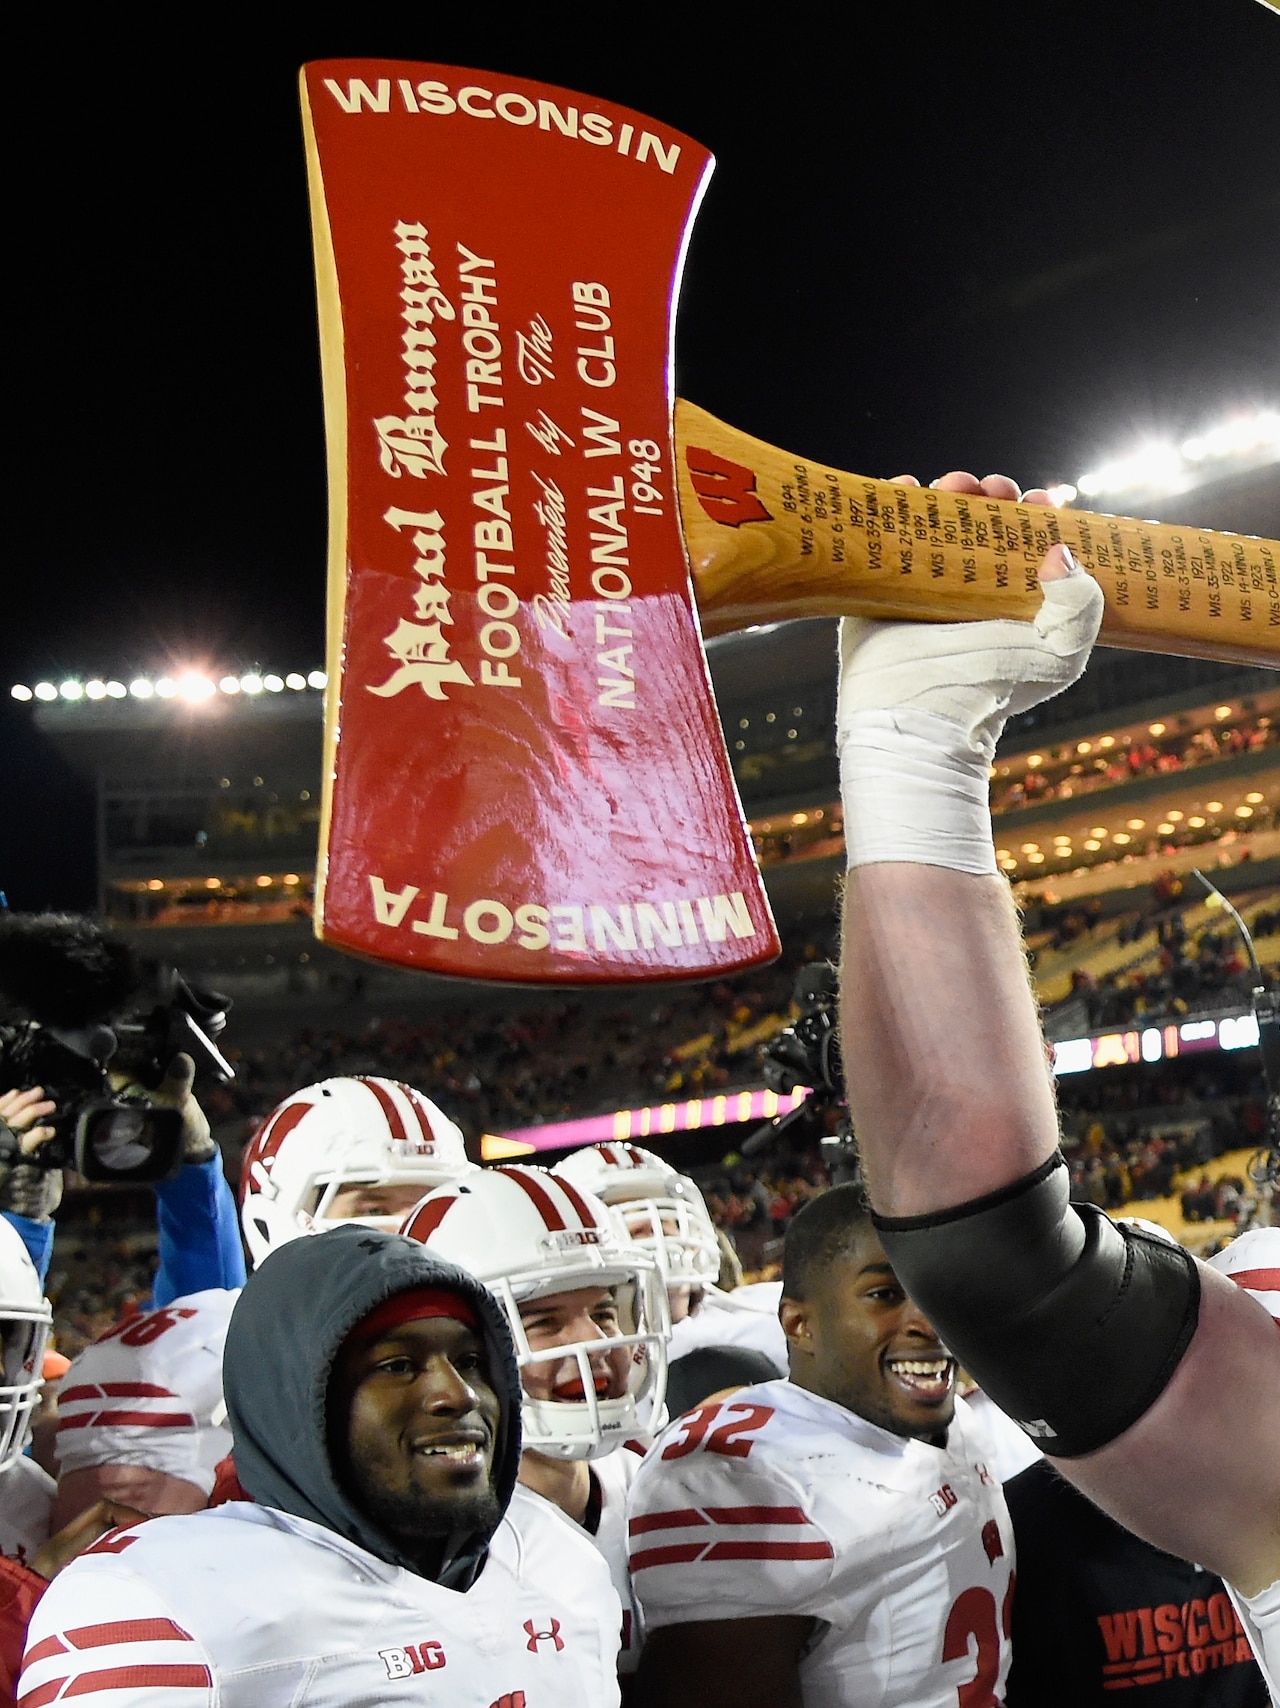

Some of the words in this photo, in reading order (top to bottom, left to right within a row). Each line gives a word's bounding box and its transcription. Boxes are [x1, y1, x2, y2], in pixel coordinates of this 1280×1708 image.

[324, 79, 681, 175] WISCONSIN
[457, 241, 504, 413] TROPHY
[572, 281, 617, 388] CLUB
[374, 220, 455, 480] Bunyan
[516, 312, 555, 386] The
[525, 409, 576, 456] by
[581, 408, 623, 458] W
[629, 439, 663, 515] 1948
[782, 485, 797, 513] 1894
[815, 491, 827, 519] 1896
[850, 498, 864, 527] 1897
[882, 505, 895, 533] 1898
[914, 515, 927, 540] 1899
[944, 521, 957, 544] 1901
[976, 520, 989, 548] 1905
[1006, 525, 1019, 551] 1907
[1035, 530, 1048, 557] 1908
[472, 428, 522, 687] FOOTBALL
[531, 468, 573, 641] Presented
[1097, 545, 1110, 567] 1912
[1128, 549, 1142, 573] 1917
[1161, 550, 1175, 578] 1920
[1191, 557, 1205, 579] 1921
[1221, 561, 1235, 586] 1922
[1251, 565, 1264, 591] 1923
[366, 505, 475, 700] Paul
[587, 474, 636, 709] NATIONAL
[369, 874, 756, 952] MINNESOTA
[661, 1403, 775, 1461] 32
